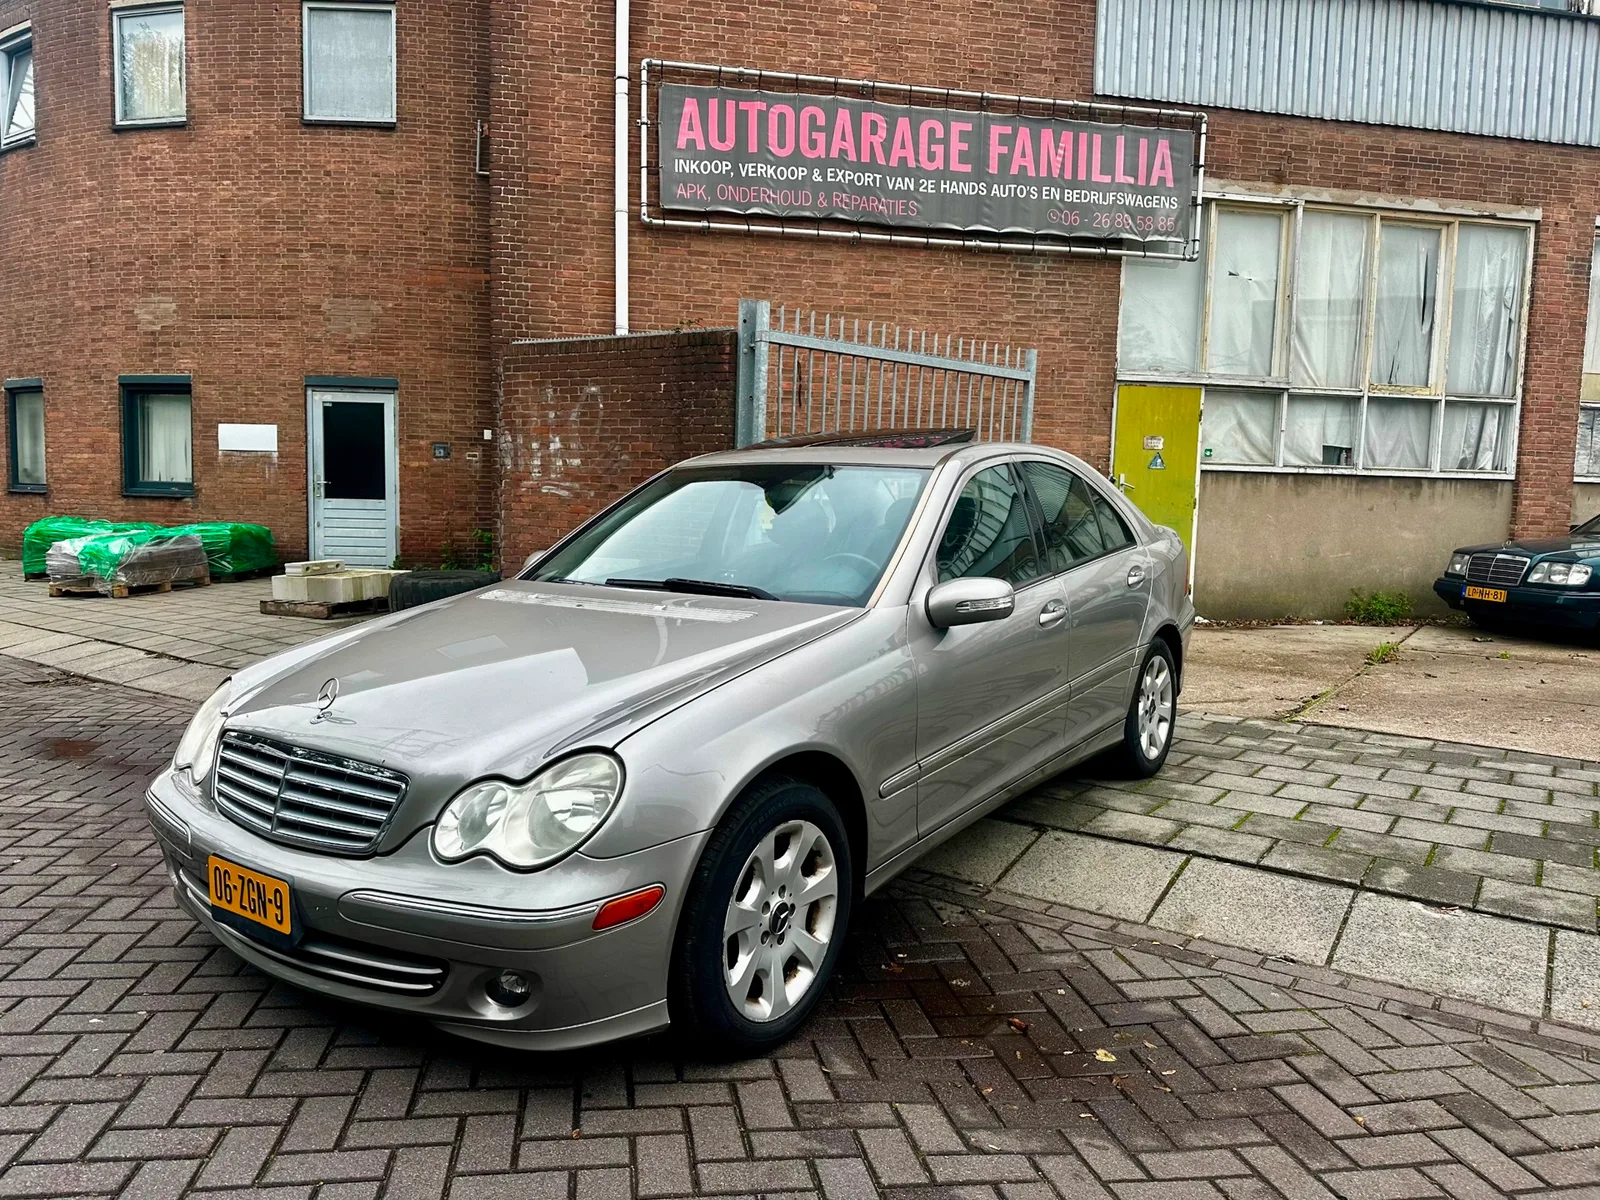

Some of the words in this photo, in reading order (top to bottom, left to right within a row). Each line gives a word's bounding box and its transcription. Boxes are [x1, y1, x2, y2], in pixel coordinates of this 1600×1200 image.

[676, 97, 973, 173] AUTOGARAGE
[988, 124, 1174, 188] FAMILLIA
[674, 158, 734, 178] INKOOP,
[739, 163, 808, 181] VERKOOP
[812, 168, 823, 182] &
[827, 168, 882, 187] EXPORT
[886, 175, 914, 191] VAN
[919, 179, 936, 194] 2E
[940, 180, 987, 196] HANDS
[990, 184, 1038, 200] AUTO'S
[1042, 188, 1061, 202] EN
[1064, 189, 1178, 210] BEDRIJFSWAGENS
[676, 183, 711, 202] APK,
[717, 183, 812, 206] ONDERHOUD
[818, 192, 828, 208] &
[832, 193, 917, 216] REPARATIES
[1061, 210, 1080, 226] 06
[1092, 212, 1110, 228] 26
[1114, 213, 1132, 229] 89
[1136, 216, 1153, 231] 58
[1158, 217, 1175, 232] 85
[213, 865, 284, 925] 06-ZGN-9
